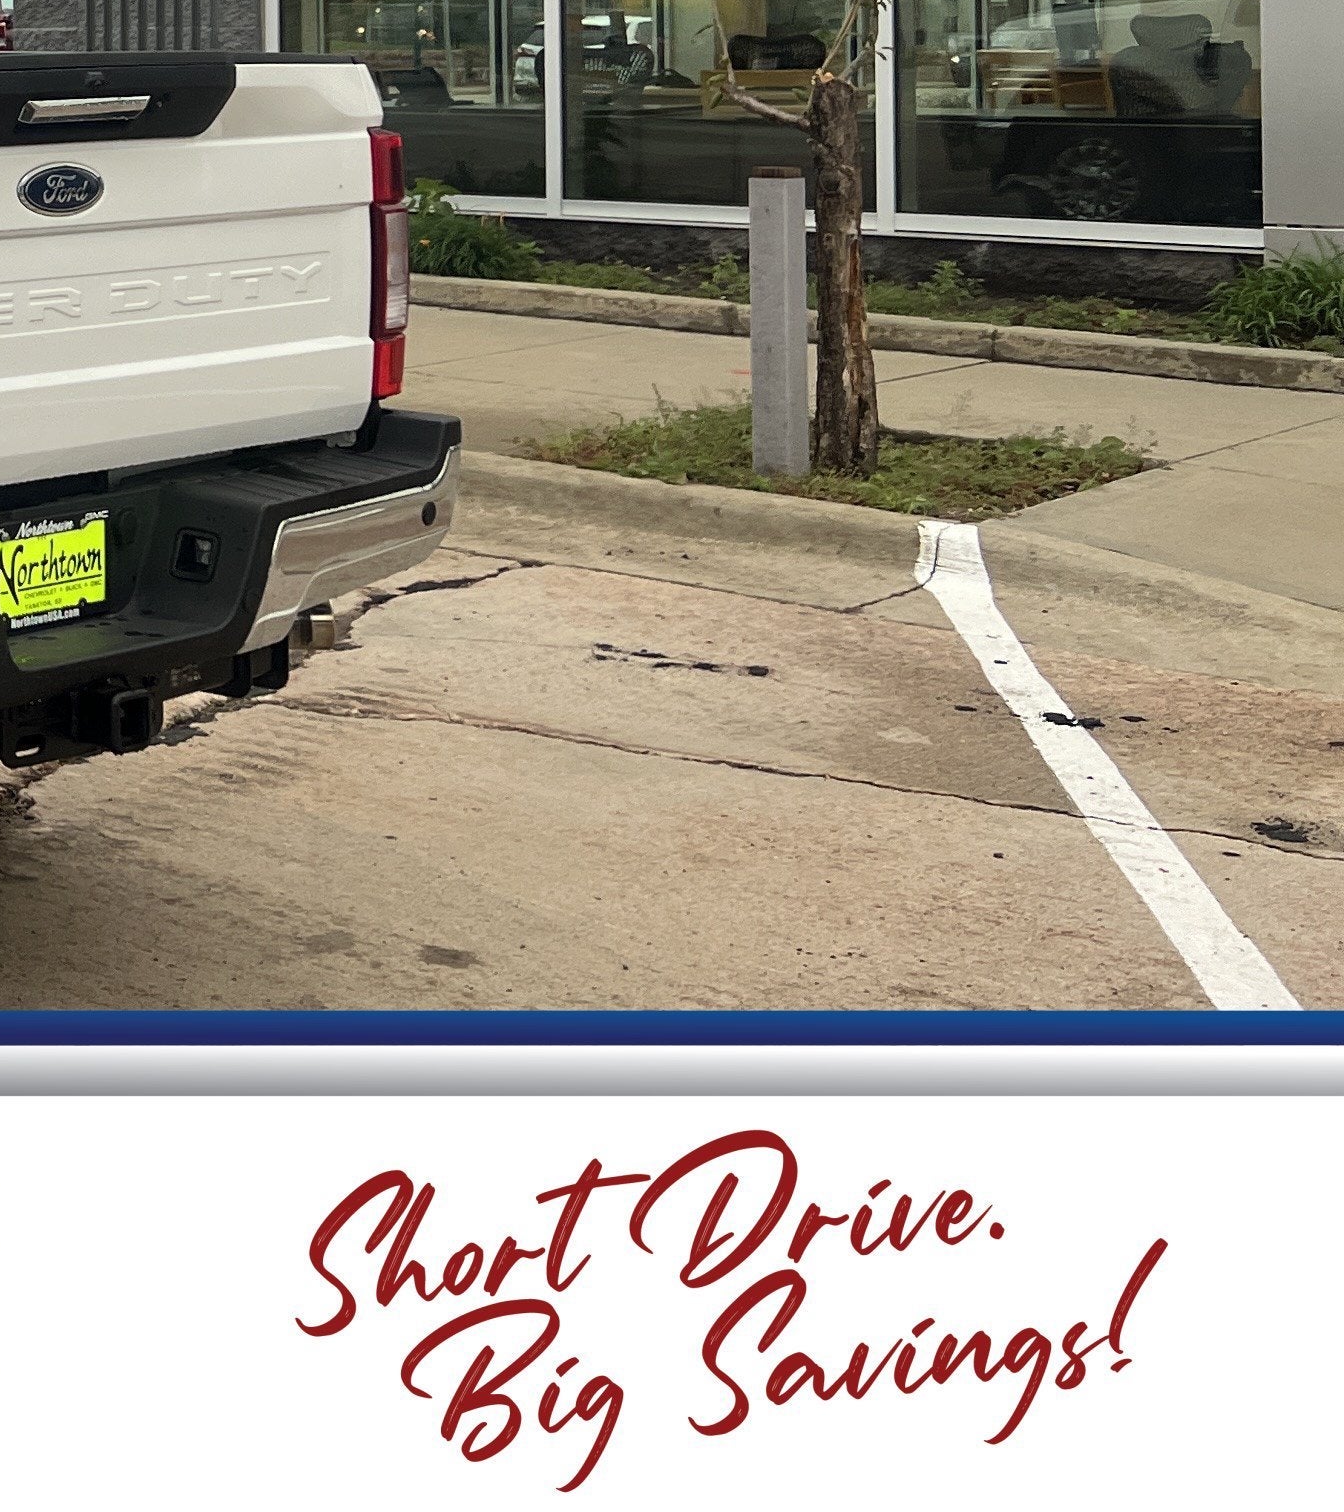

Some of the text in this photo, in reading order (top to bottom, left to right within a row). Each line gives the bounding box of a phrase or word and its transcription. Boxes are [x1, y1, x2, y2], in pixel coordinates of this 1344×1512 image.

[43, 174, 89, 204] Ford
[109, 260, 323, 315] DUTY
[14, 519, 75, 540] Northtown
[10, 608, 80, 629] NorthtownUSA.com
